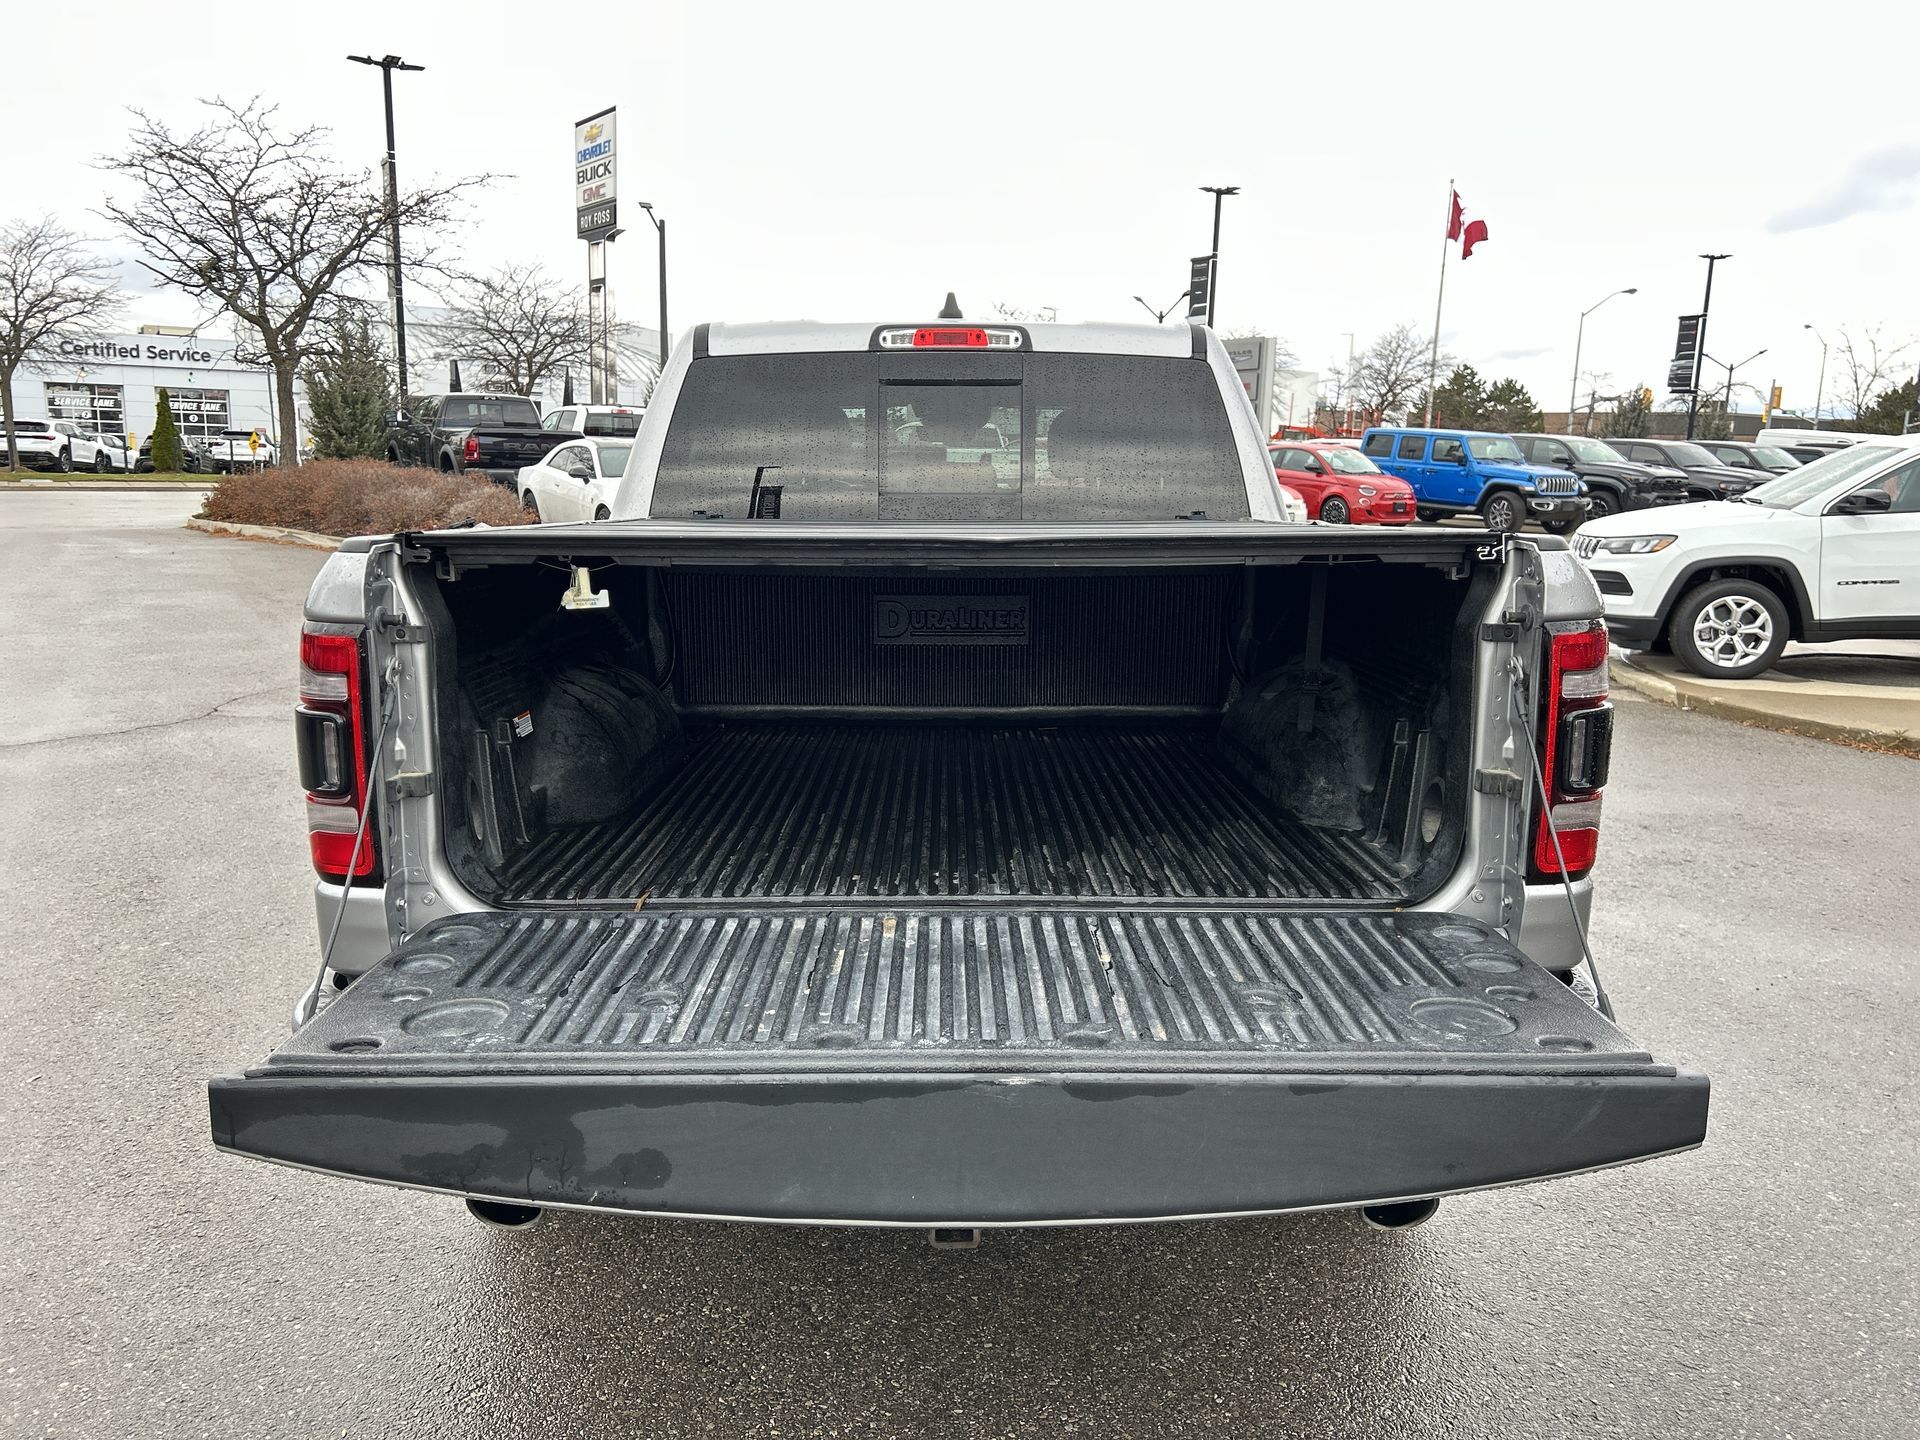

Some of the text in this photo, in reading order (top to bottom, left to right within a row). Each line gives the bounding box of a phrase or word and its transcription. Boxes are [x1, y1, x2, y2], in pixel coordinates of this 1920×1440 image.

[577, 139, 612, 164] CHEVROLET
[577, 160, 612, 185] BUICK
[582, 183, 606, 203] GMC
[580, 209, 611, 229] ROY FOSS
[59, 340, 212, 363] Certified Service
[54, 397, 116, 408] SERVICE LANE
[169, 401, 222, 412] ERVICE LANE
